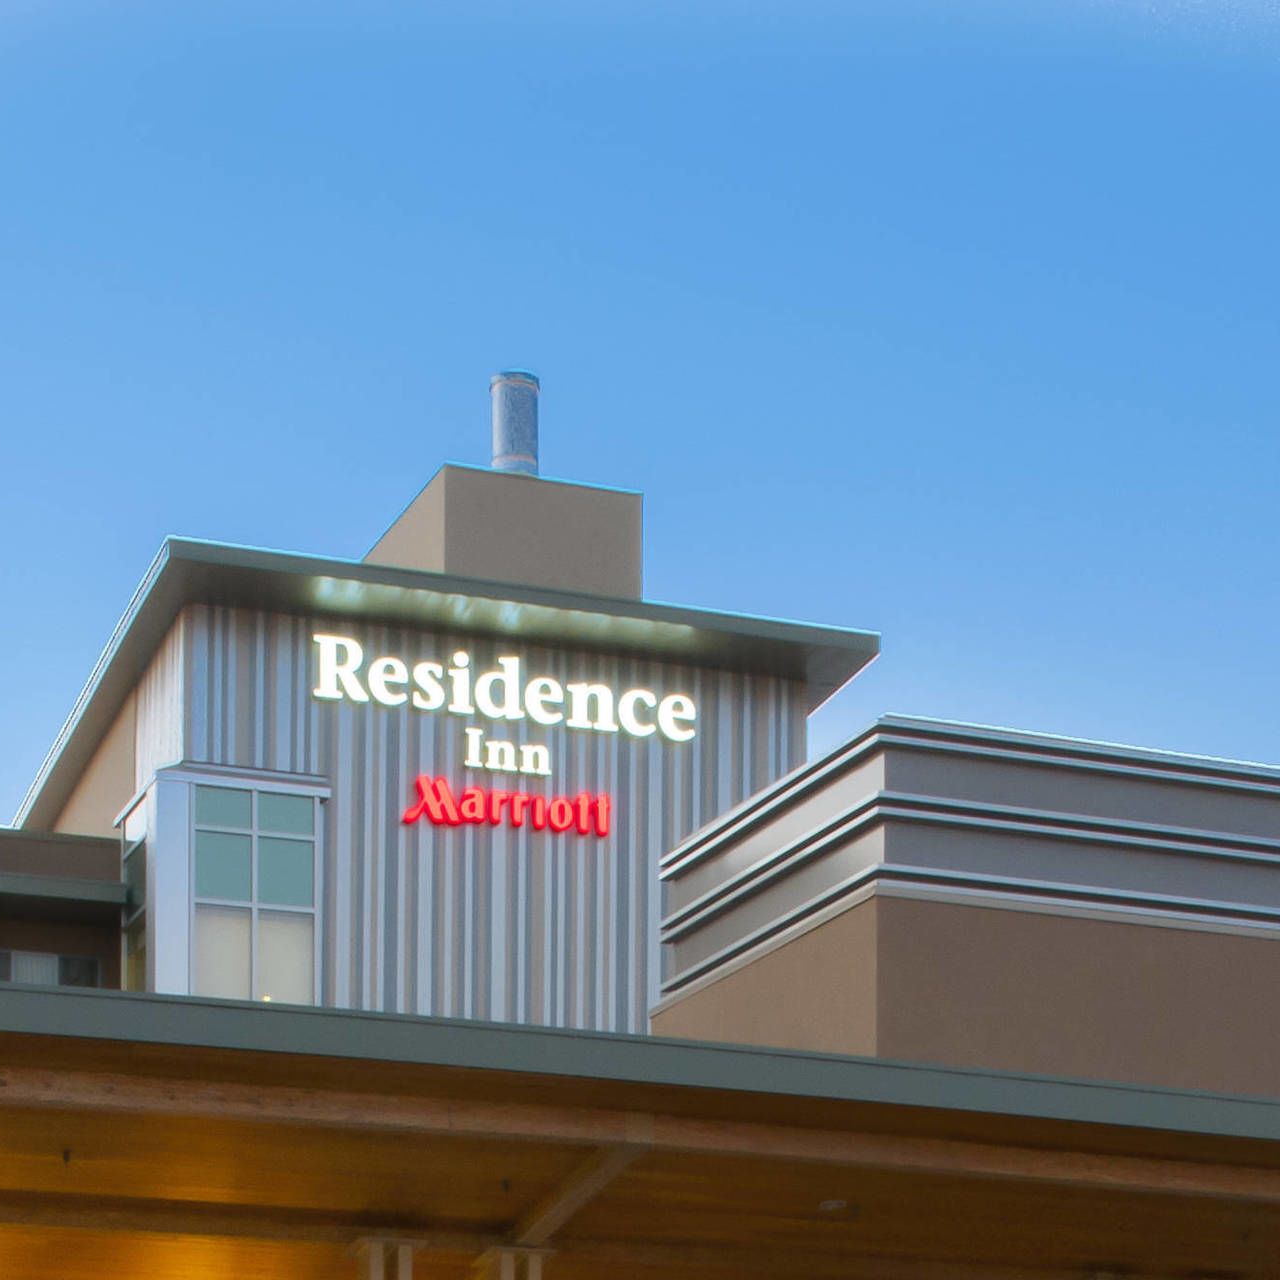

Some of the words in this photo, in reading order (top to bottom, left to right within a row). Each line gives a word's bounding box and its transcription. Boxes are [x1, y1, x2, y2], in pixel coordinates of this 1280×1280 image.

[313, 633, 696, 742] Residence
[464, 727, 553, 776] Inn
[402, 774, 611, 836] Marriott
